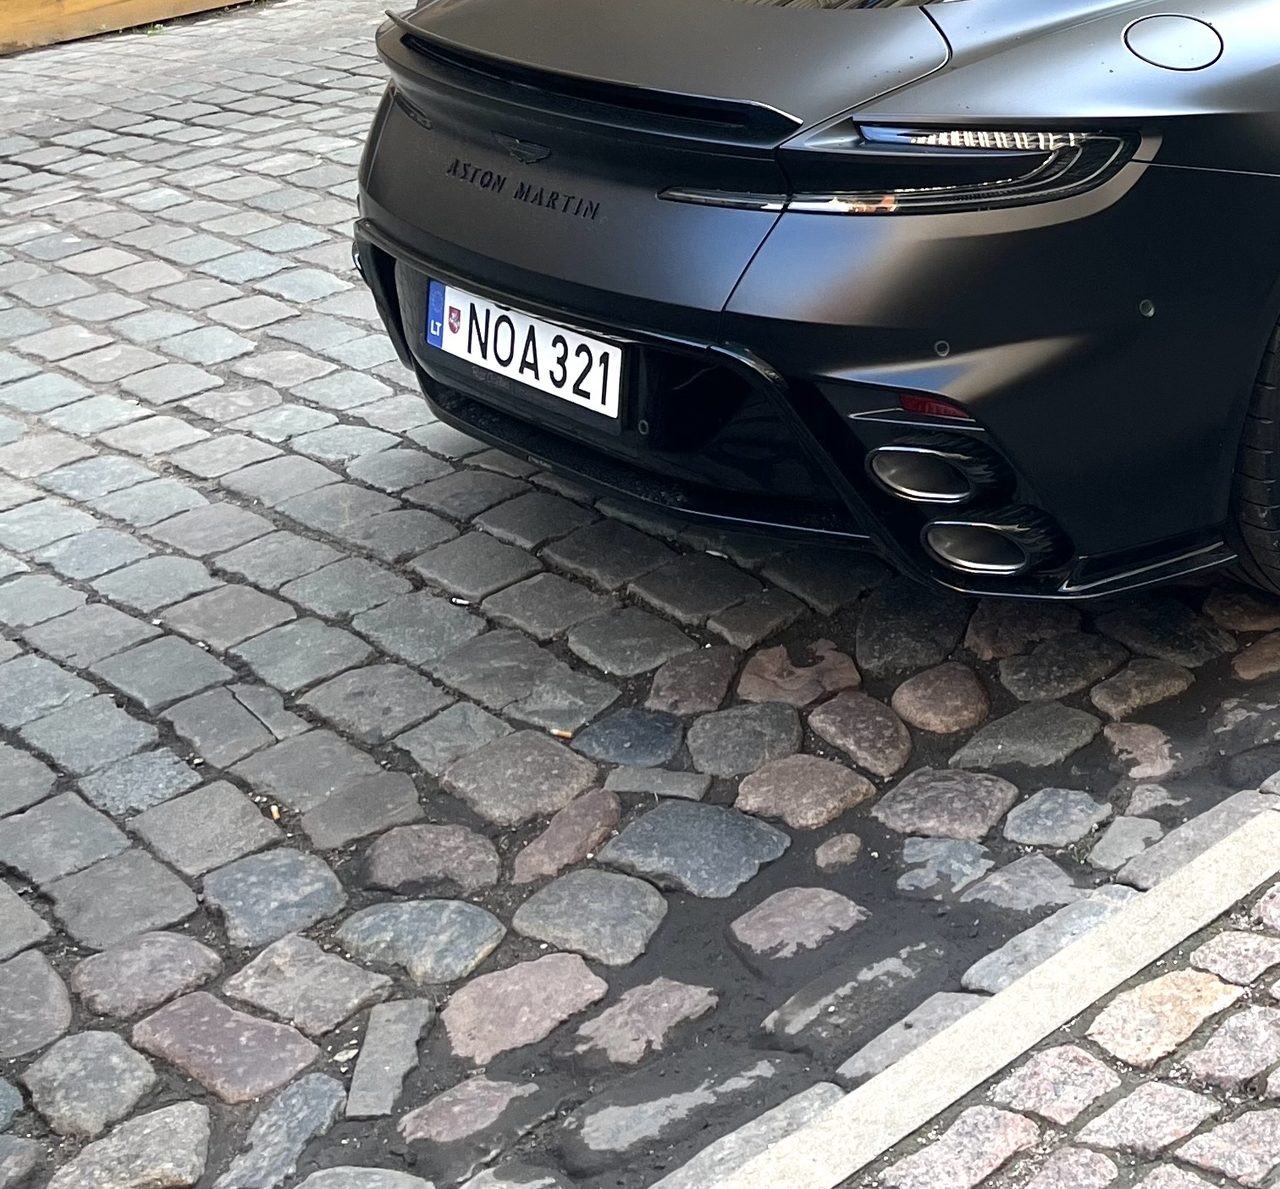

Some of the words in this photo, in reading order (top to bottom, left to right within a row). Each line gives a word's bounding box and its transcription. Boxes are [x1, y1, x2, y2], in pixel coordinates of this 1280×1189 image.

[447, 158, 507, 193] ASTON
[513, 181, 601, 221] MARTIN
[467, 302, 540, 382] NOA
[549, 334, 611, 406] 321
